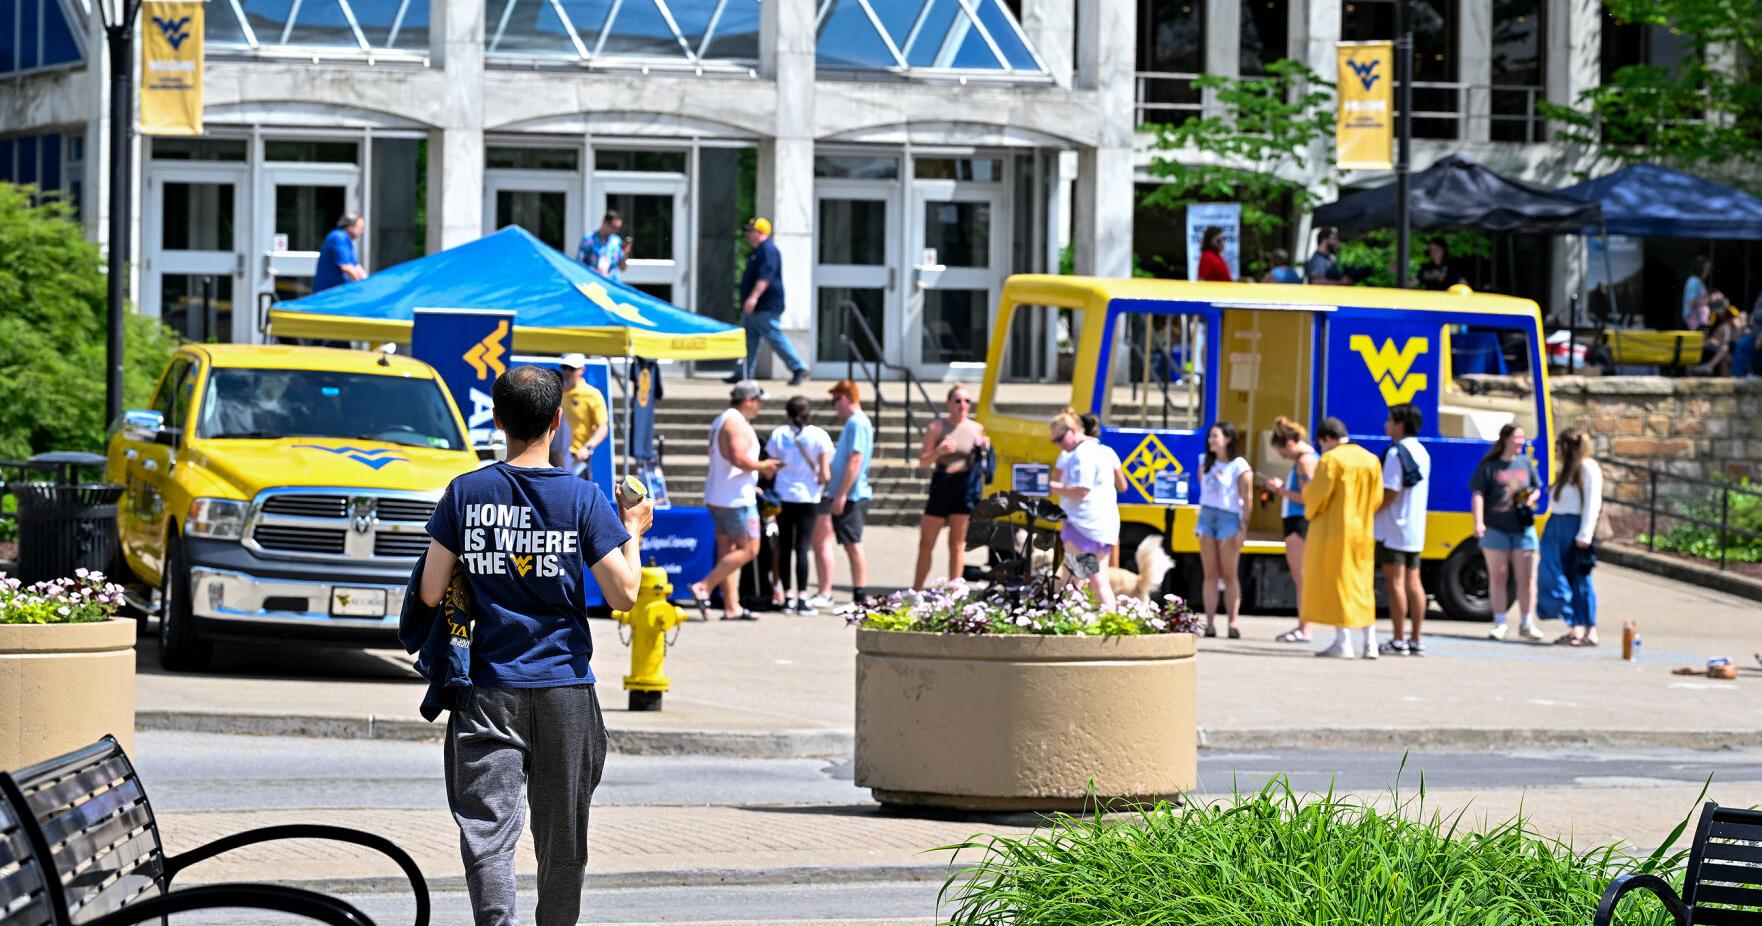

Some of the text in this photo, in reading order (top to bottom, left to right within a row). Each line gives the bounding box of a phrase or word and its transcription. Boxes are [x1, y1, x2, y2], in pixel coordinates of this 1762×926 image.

[465, 503, 532, 529] HOME
[464, 527, 578, 554] IS WHERE
[464, 551, 507, 575] THE
[535, 554, 565, 578] IS.
